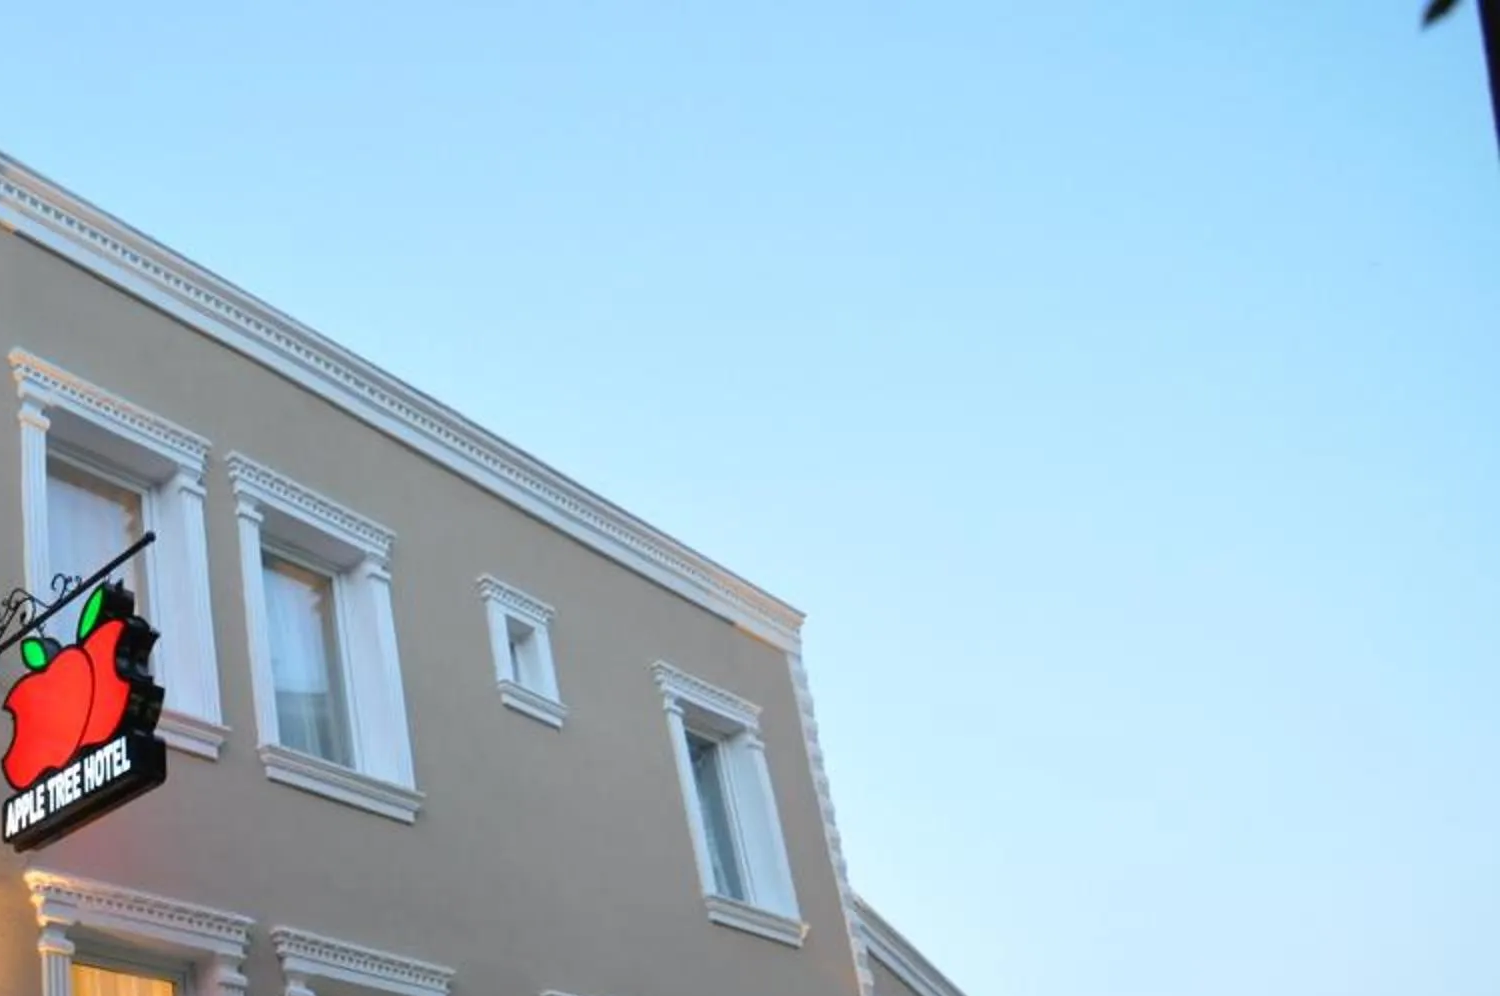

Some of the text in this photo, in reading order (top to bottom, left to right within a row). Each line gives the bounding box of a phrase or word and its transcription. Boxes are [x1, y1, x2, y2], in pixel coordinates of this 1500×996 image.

[6, 735, 131, 838] APPLE TREE HOTEL
